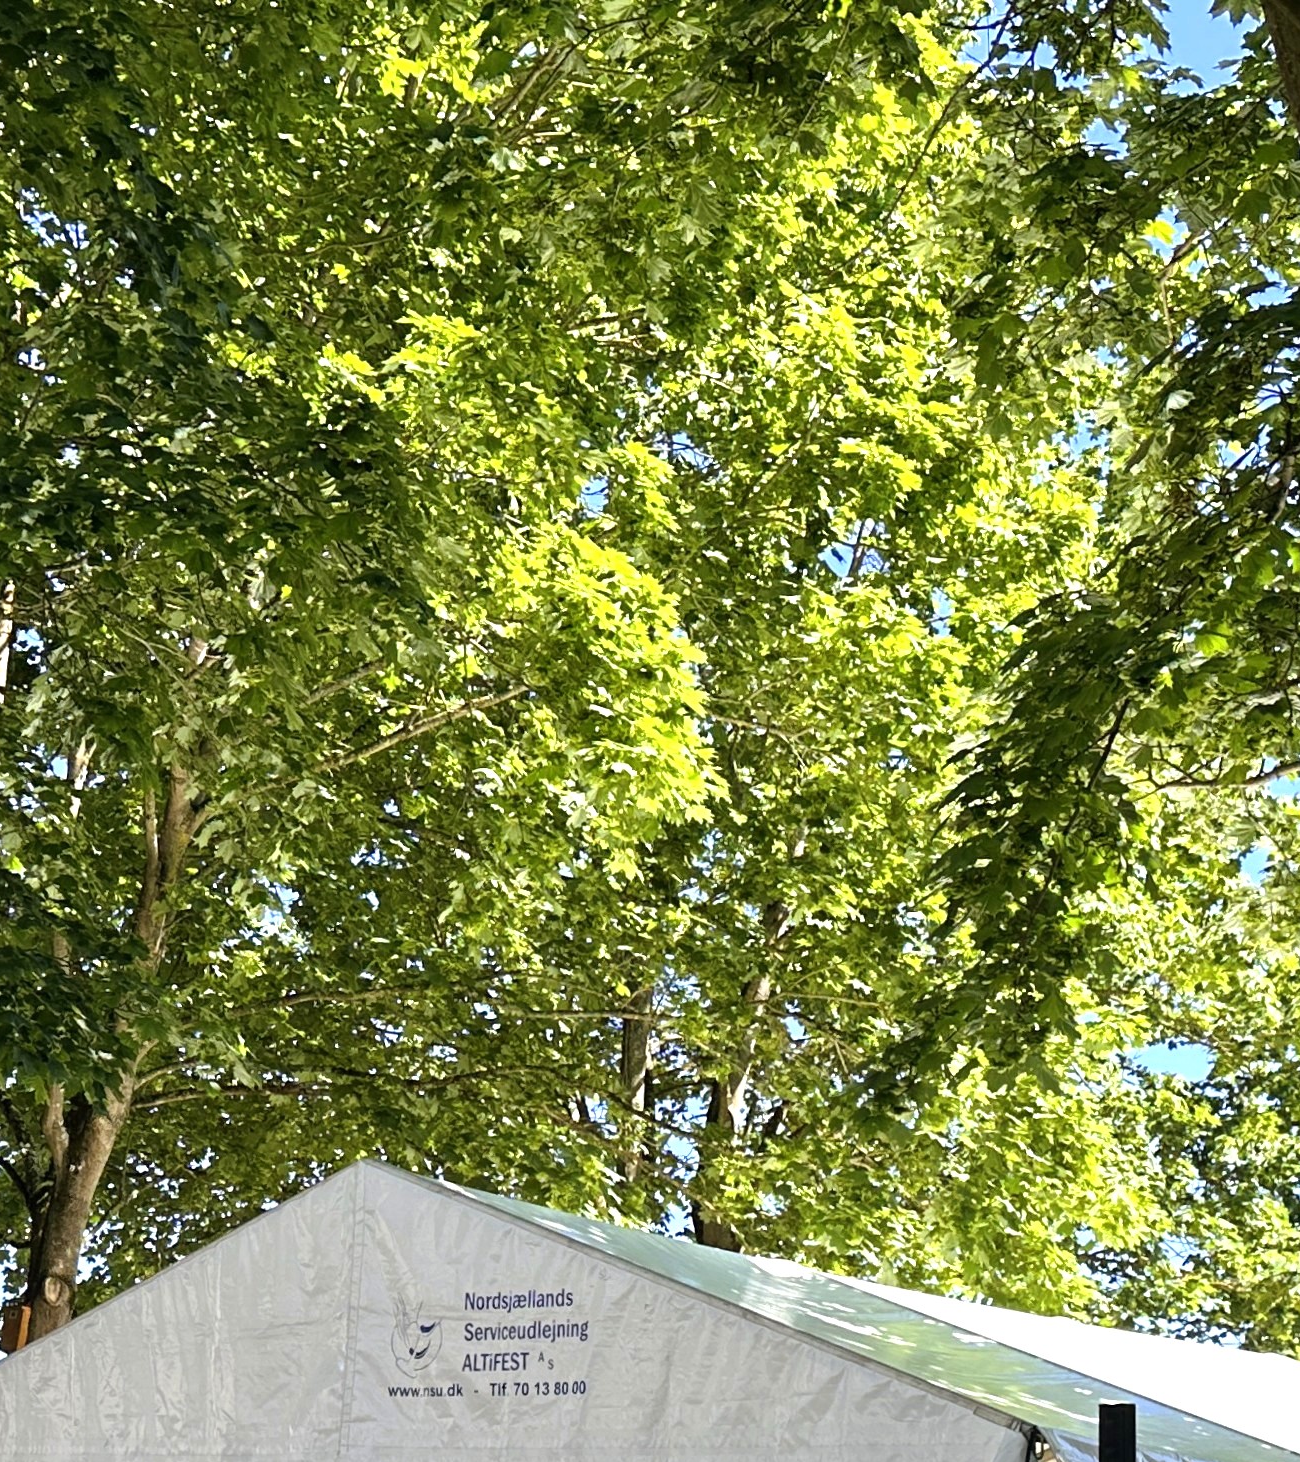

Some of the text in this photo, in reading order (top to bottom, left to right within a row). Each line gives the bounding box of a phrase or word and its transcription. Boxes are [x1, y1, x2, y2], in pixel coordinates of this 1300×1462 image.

[464, 1288, 573, 1313] Nordsjællands
[464, 1320, 589, 1343] Serviceudlejning
[388, 1384, 463, 1398] www.nsu.dk
[513, 1382, 530, 1396] 70
[534, 1382, 550, 1396] 13
[553, 1381, 569, 1395] 80
[571, 1380, 587, 1395] 00
